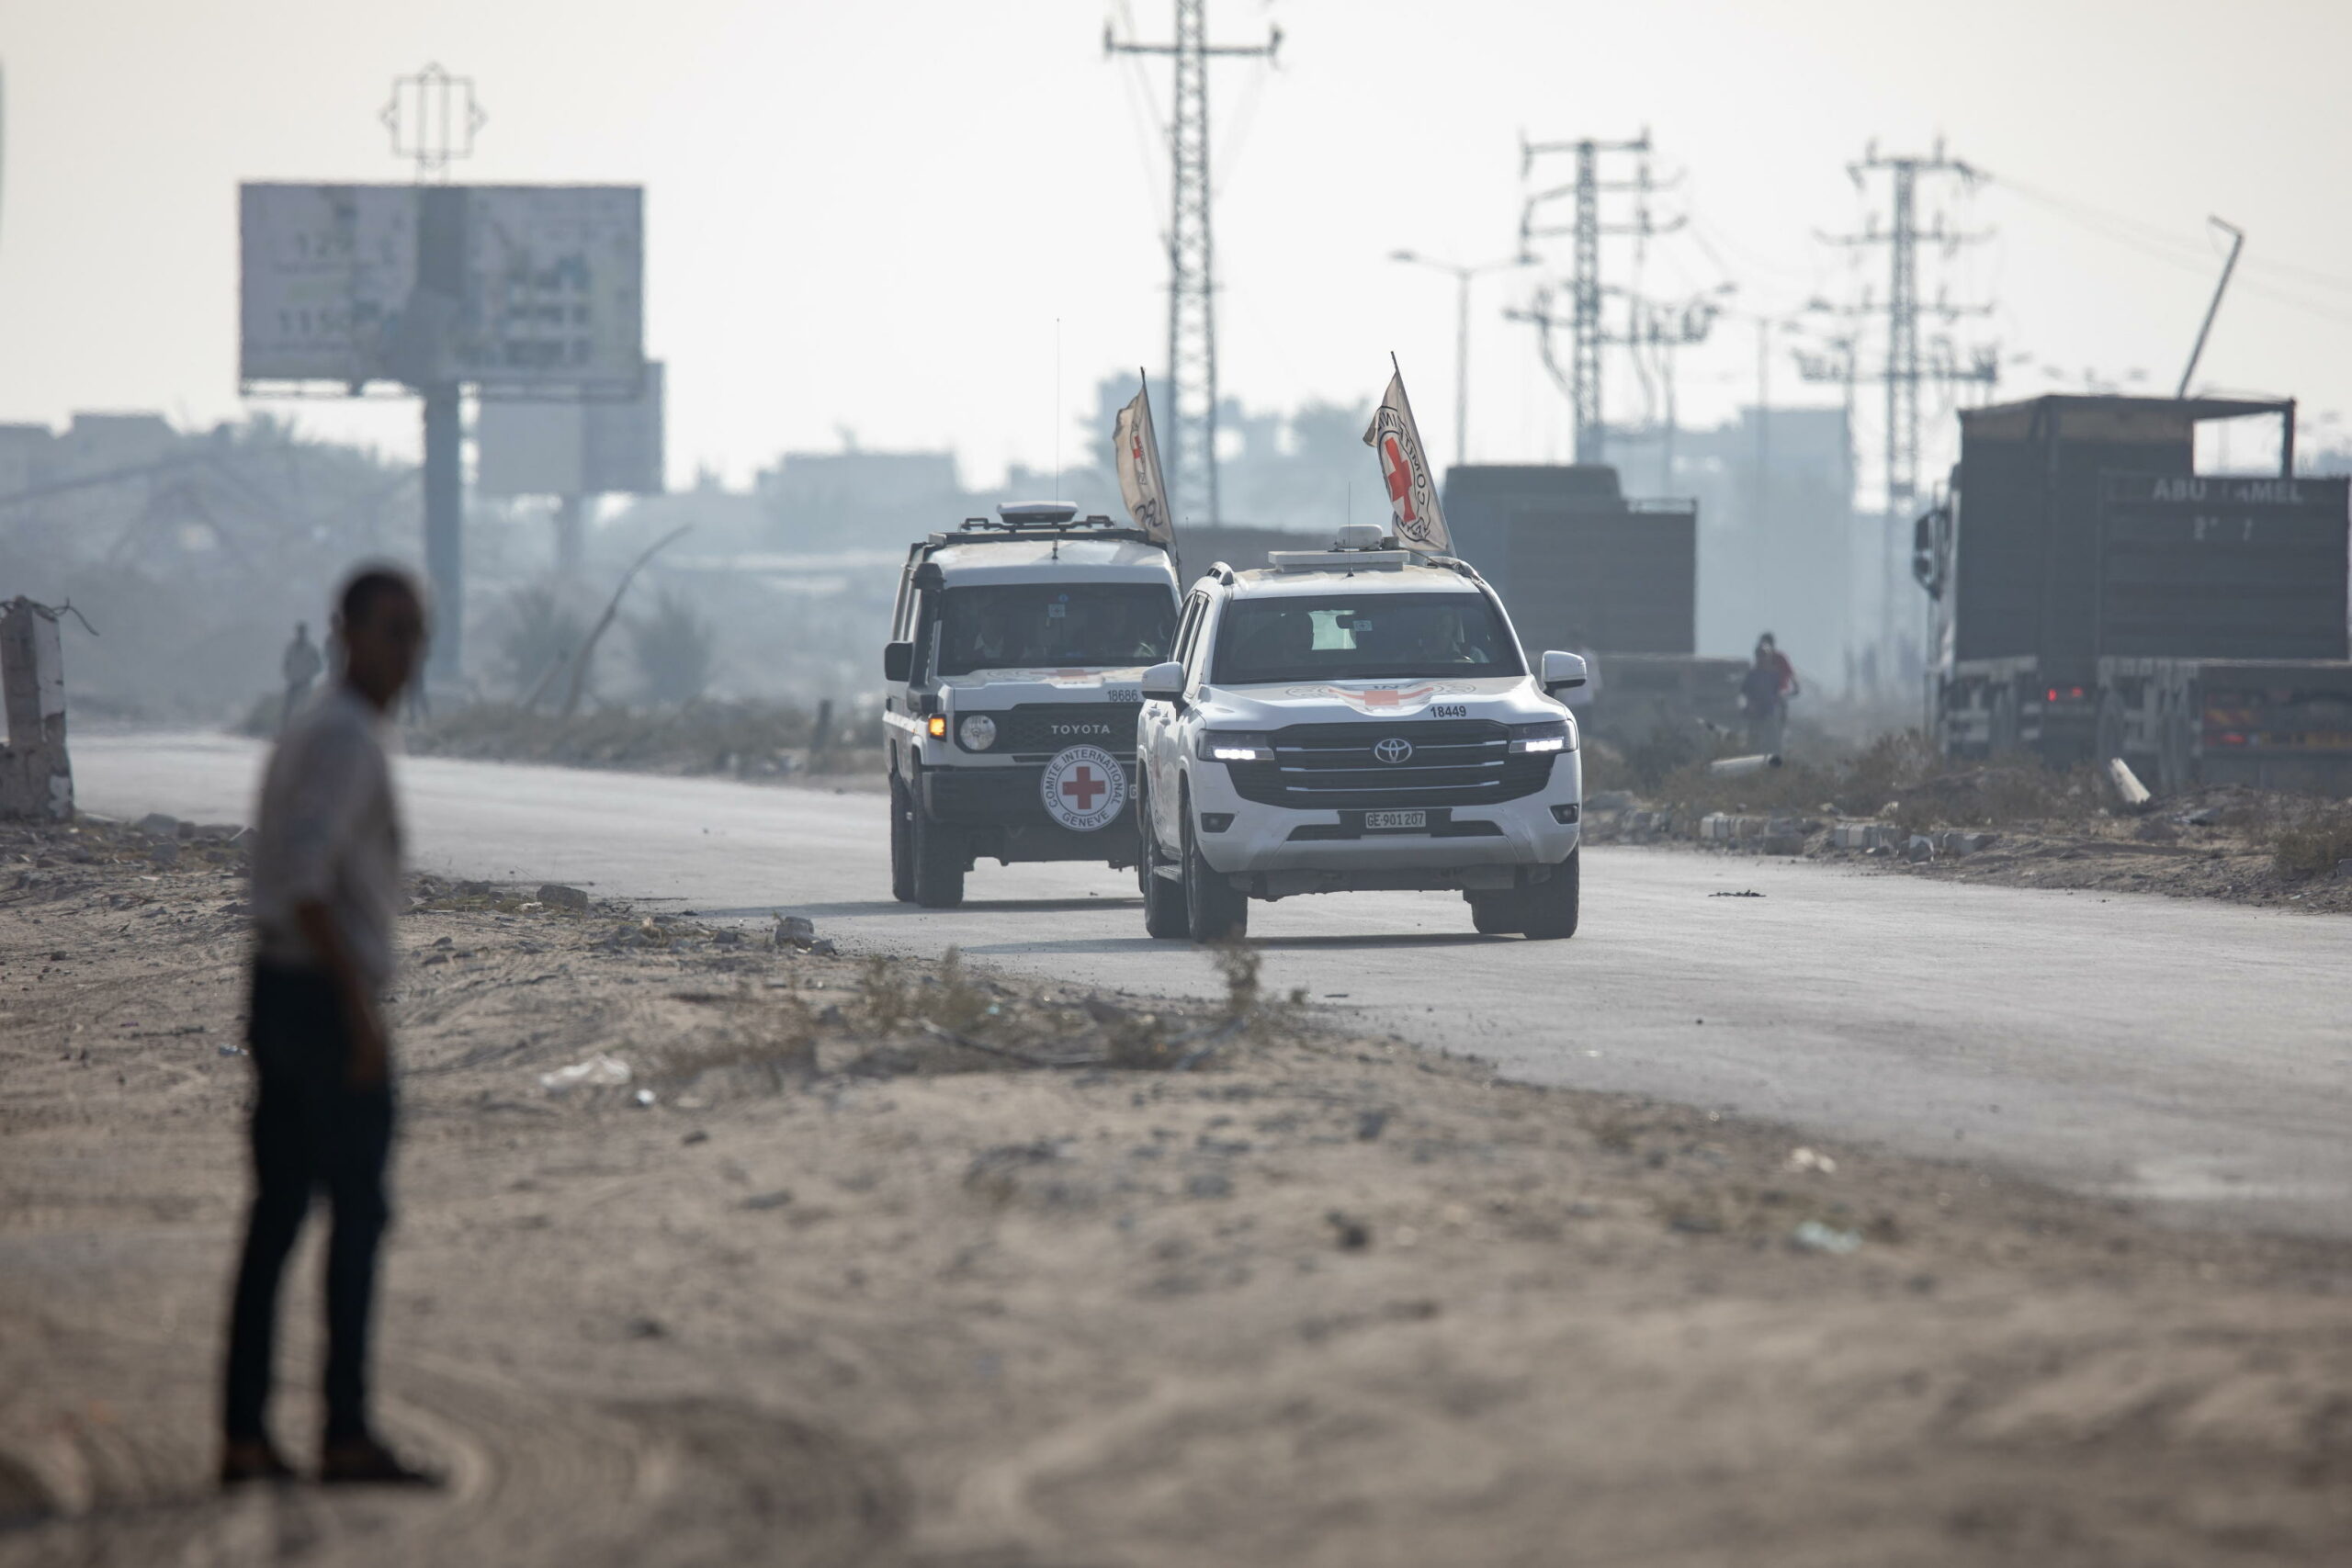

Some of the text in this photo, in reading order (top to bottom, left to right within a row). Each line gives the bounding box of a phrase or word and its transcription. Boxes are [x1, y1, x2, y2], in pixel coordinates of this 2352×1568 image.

[2153, 479, 2206, 502] ABU
[1107, 690, 1138, 702] 18686
[1430, 705, 1467, 718] 18449
[1051, 725, 1111, 735] TOYOTA
[1046, 749, 1123, 808] COMITE INTERNATIONAL
[1062, 810, 1111, 828] GENEVE
